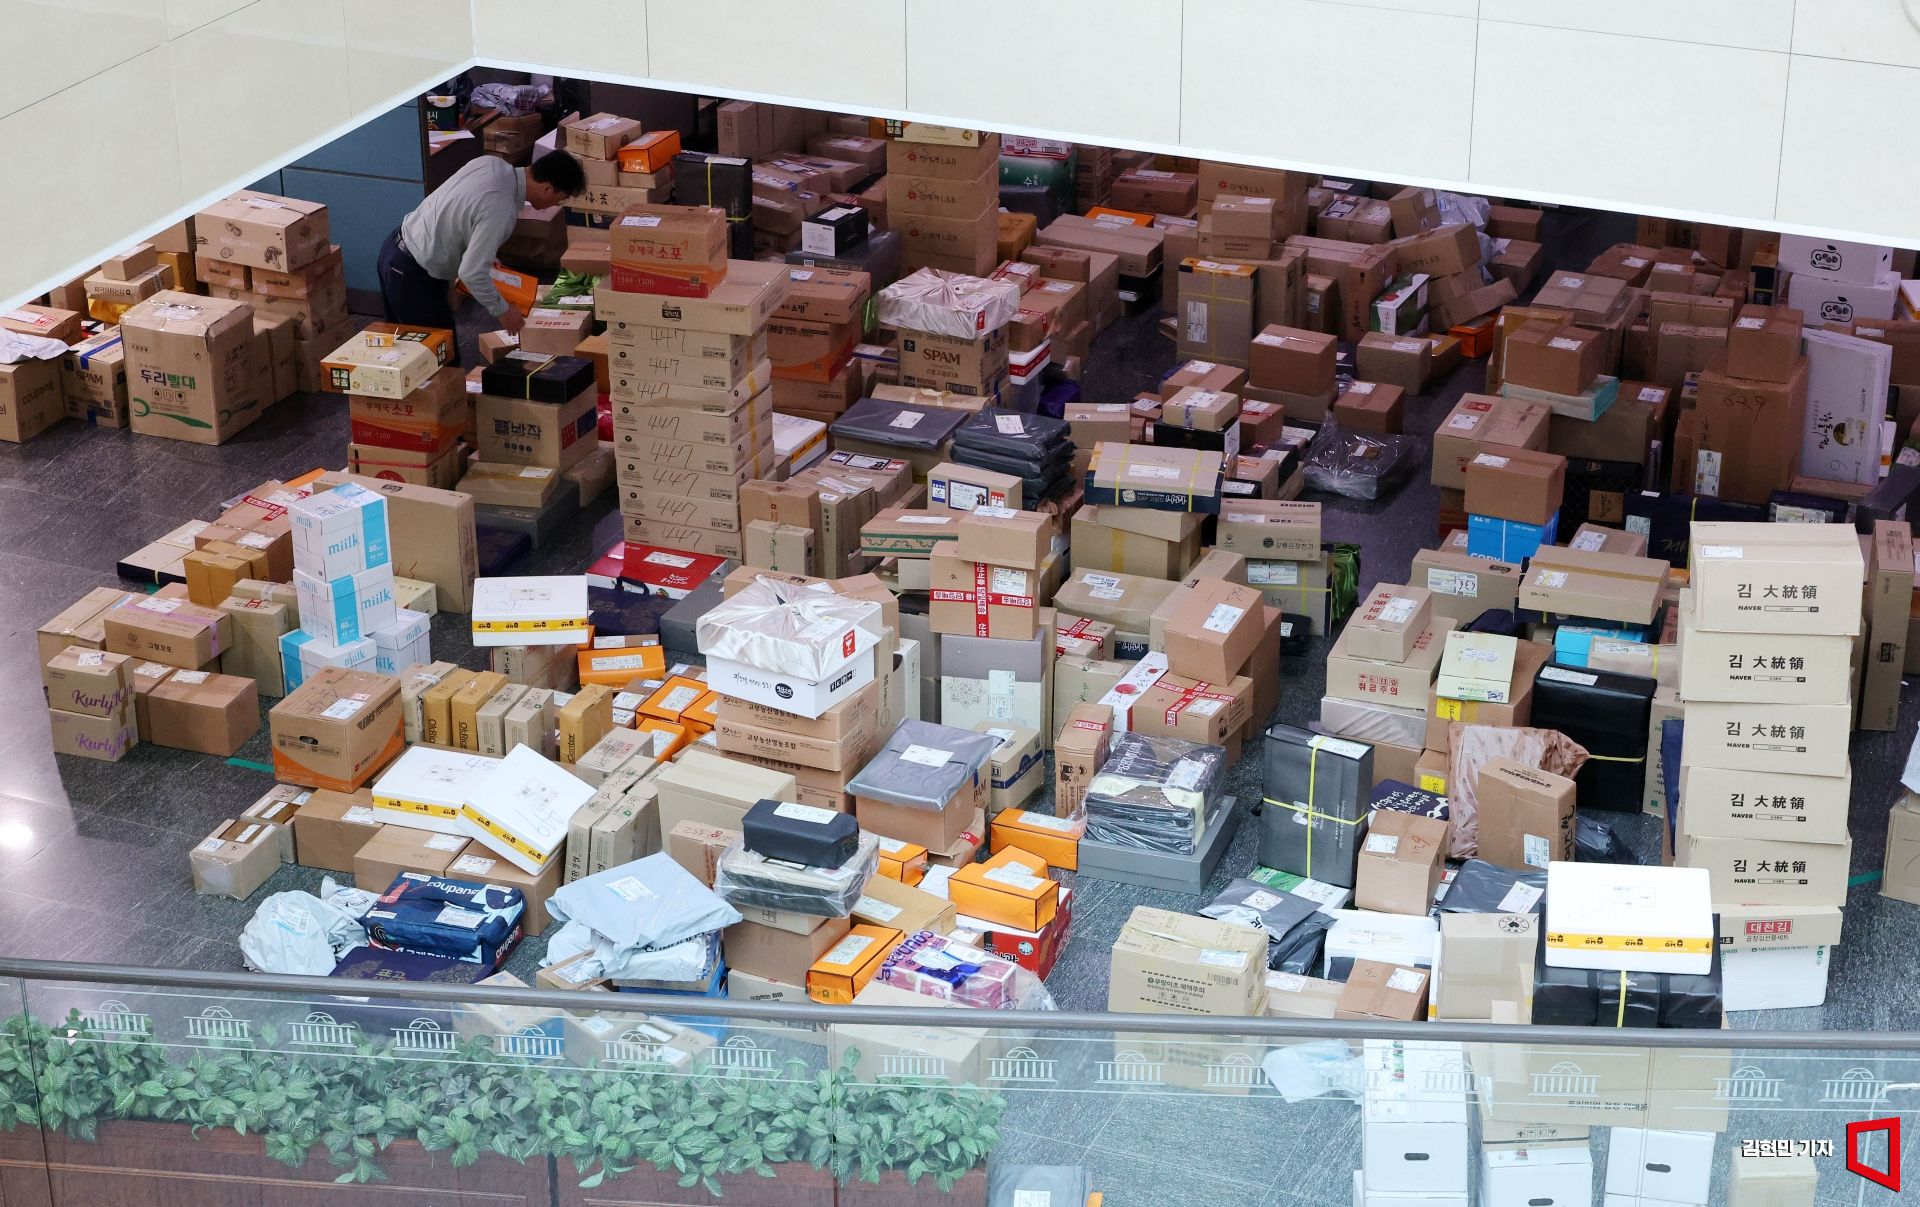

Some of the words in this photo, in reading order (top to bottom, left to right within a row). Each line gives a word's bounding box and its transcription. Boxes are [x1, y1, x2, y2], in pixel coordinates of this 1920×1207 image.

[657, 246, 682, 260] 소포
[650, 328, 686, 352] 447
[922, 348, 960, 366] SPAM
[648, 357, 680, 376] 447
[392, 403, 415, 417] 소포
[647, 415, 680, 440] 447
[652, 468, 698, 497] 447
[656, 497, 698, 525] 447
[296, 515, 312, 530] miilk
[328, 533, 360, 556] miilk
[661, 526, 702, 549] 447
[302, 579, 318, 594] miilk
[1737, 584, 1752, 598] 김
[1763, 584, 1818, 600] 大統領
[362, 588, 392, 610] miilk
[1728, 654, 1743, 669] 김
[1753, 655, 1804, 670] 大統領
[72, 689, 114, 716] Kurly
[428, 718, 437, 744] OkRic
[1726, 722, 1741, 736] 김
[1751, 724, 1806, 740] 大統領
[74, 732, 117, 758] Kurly
[1730, 793, 1745, 808] 김
[1754, 794, 1805, 810] 大統領
[1733, 859, 1747, 873] 김
[1756, 860, 1806, 874] 大統領
[1750, 922, 1788, 933] 대천김
[1746, 934, 1789, 943] 곱창김선물세트
